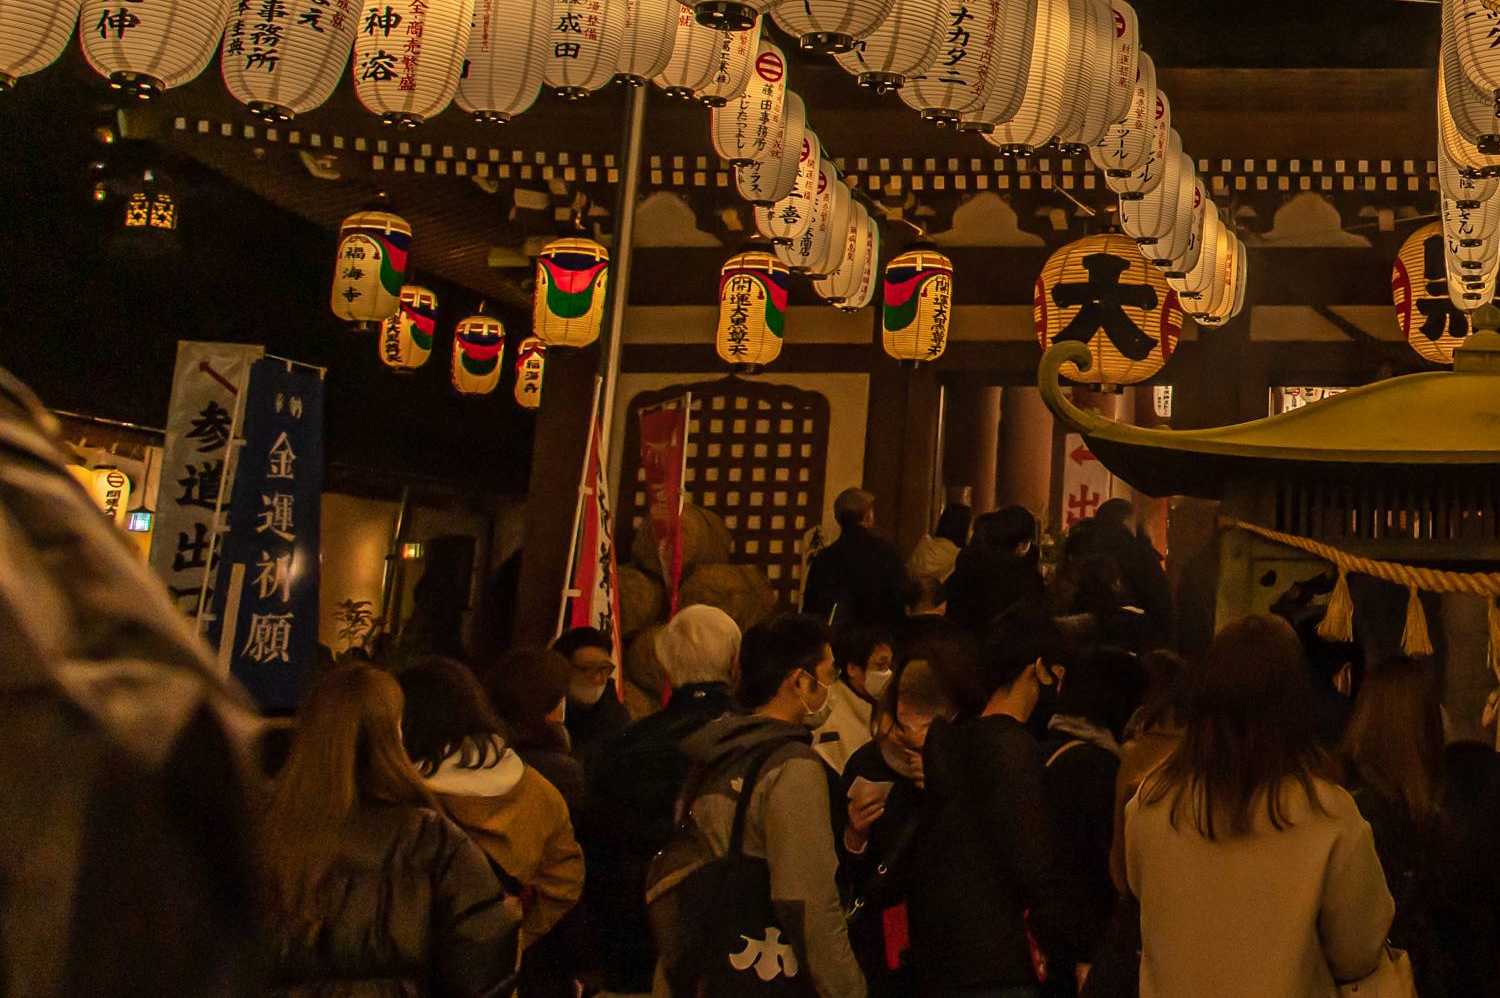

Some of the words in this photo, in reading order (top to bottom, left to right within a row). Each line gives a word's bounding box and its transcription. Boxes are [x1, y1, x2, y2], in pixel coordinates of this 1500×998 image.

[727, 275, 753, 356] 開運大黒尊天
[928, 275, 951, 357] 開運大黒尊天
[1050, 252, 1160, 362] 大
[240, 430, 298, 664] 金運祈願
